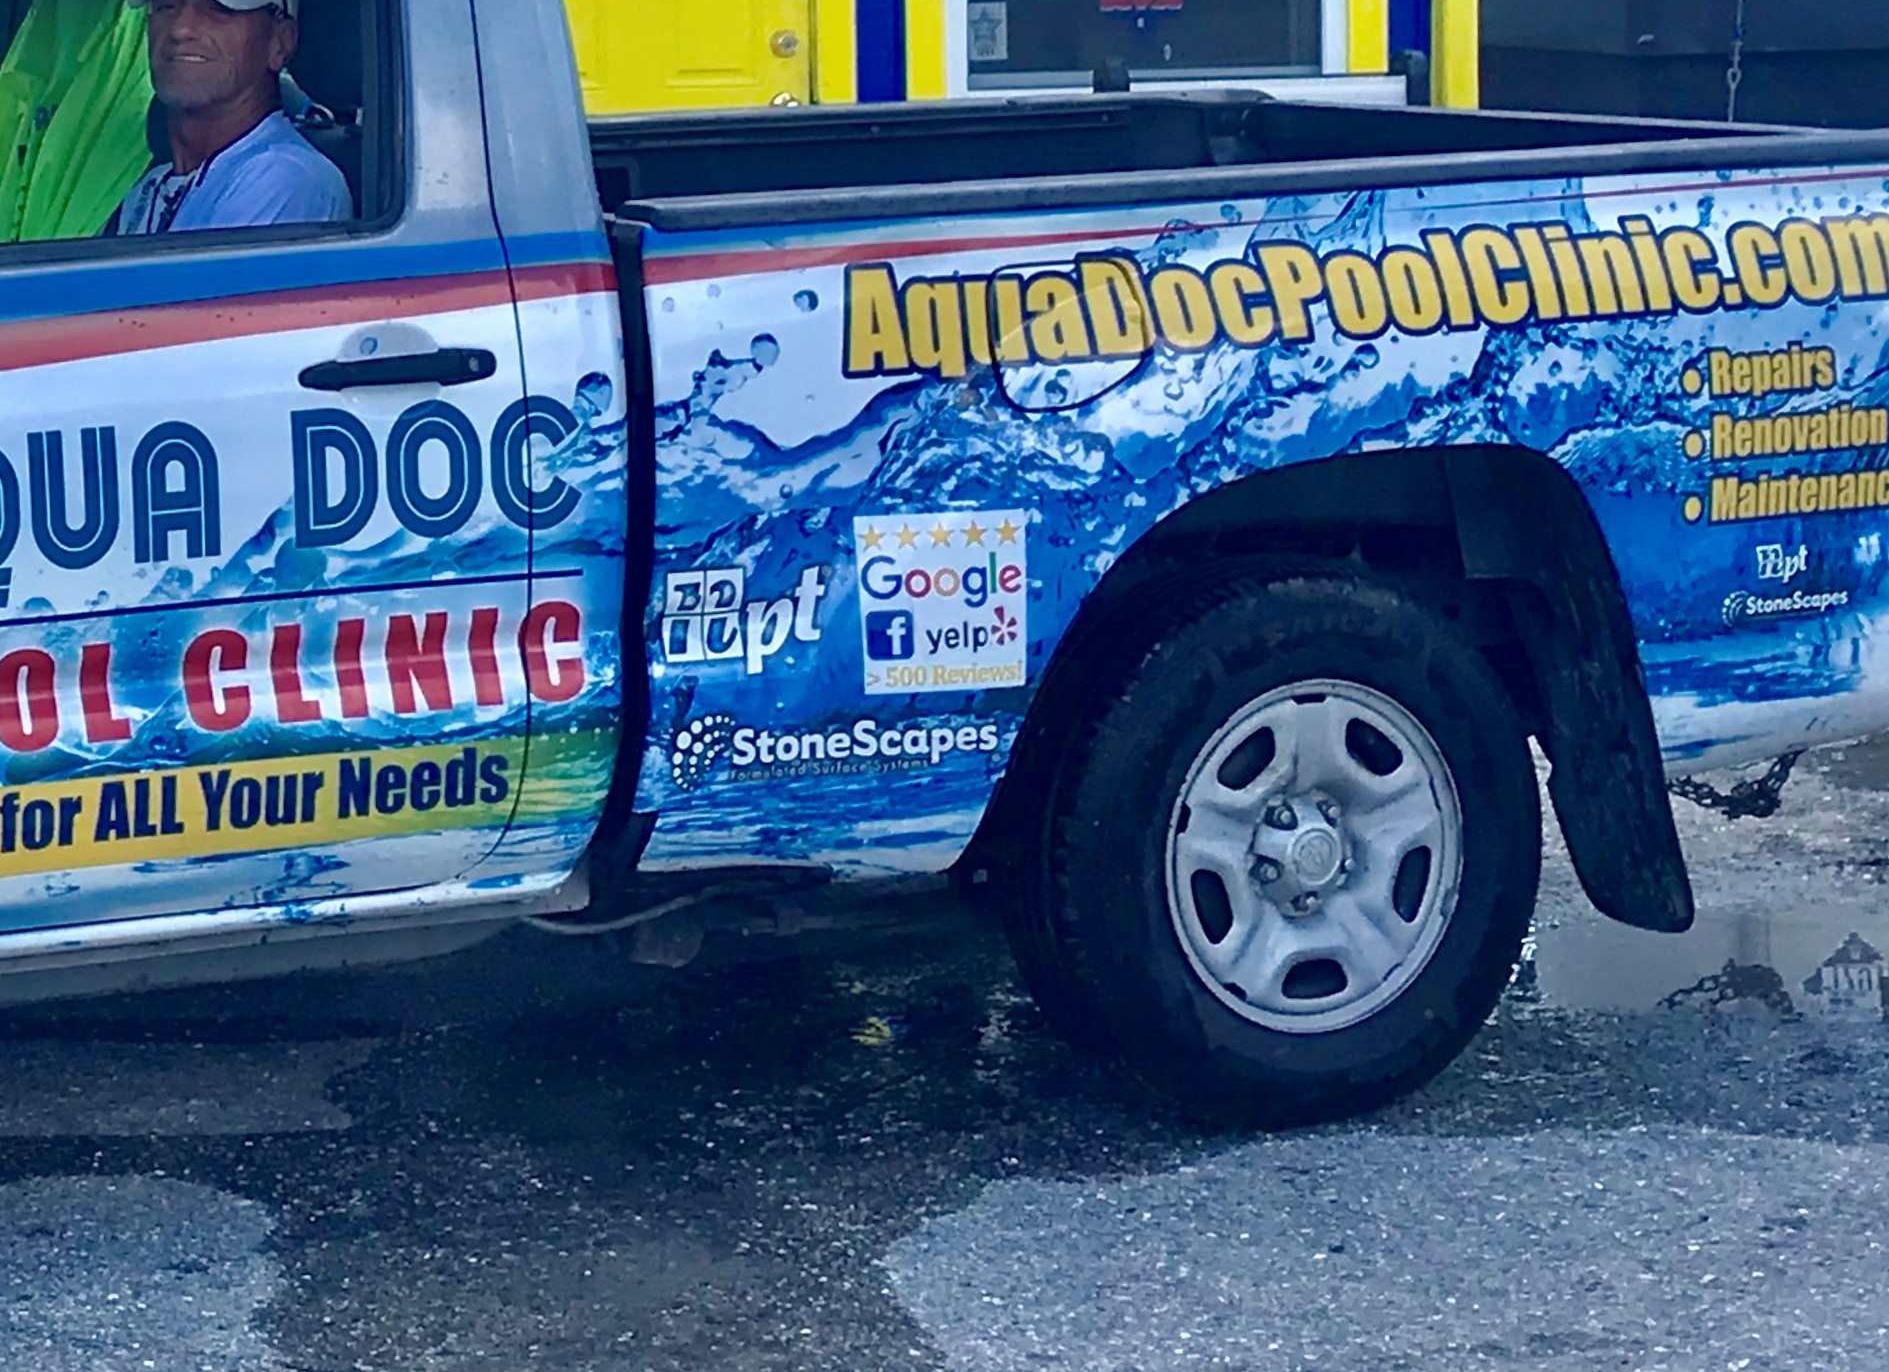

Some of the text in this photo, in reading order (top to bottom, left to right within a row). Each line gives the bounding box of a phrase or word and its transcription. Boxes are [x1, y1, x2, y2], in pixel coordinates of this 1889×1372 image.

[844, 211, 1889, 380] AquaDocPoolClinic.com
[1710, 344, 1836, 397] Repairs
[1711, 404, 1888, 460] Renovation
[289, 395, 583, 550] DOC
[861, 551, 1022, 608] Google
[1746, 590, 1849, 617] StoneScapes
[926, 620, 989, 655] yelp
[183, 600, 587, 733] CLINIC
[885, 665, 927, 688] 500
[932, 659, 1023, 686] Reviews!
[732, 720, 998, 765] StoneScapes
[94, 774, 184, 842] ALL
[199, 768, 324, 832] Your
[338, 747, 510, 819] Needs
